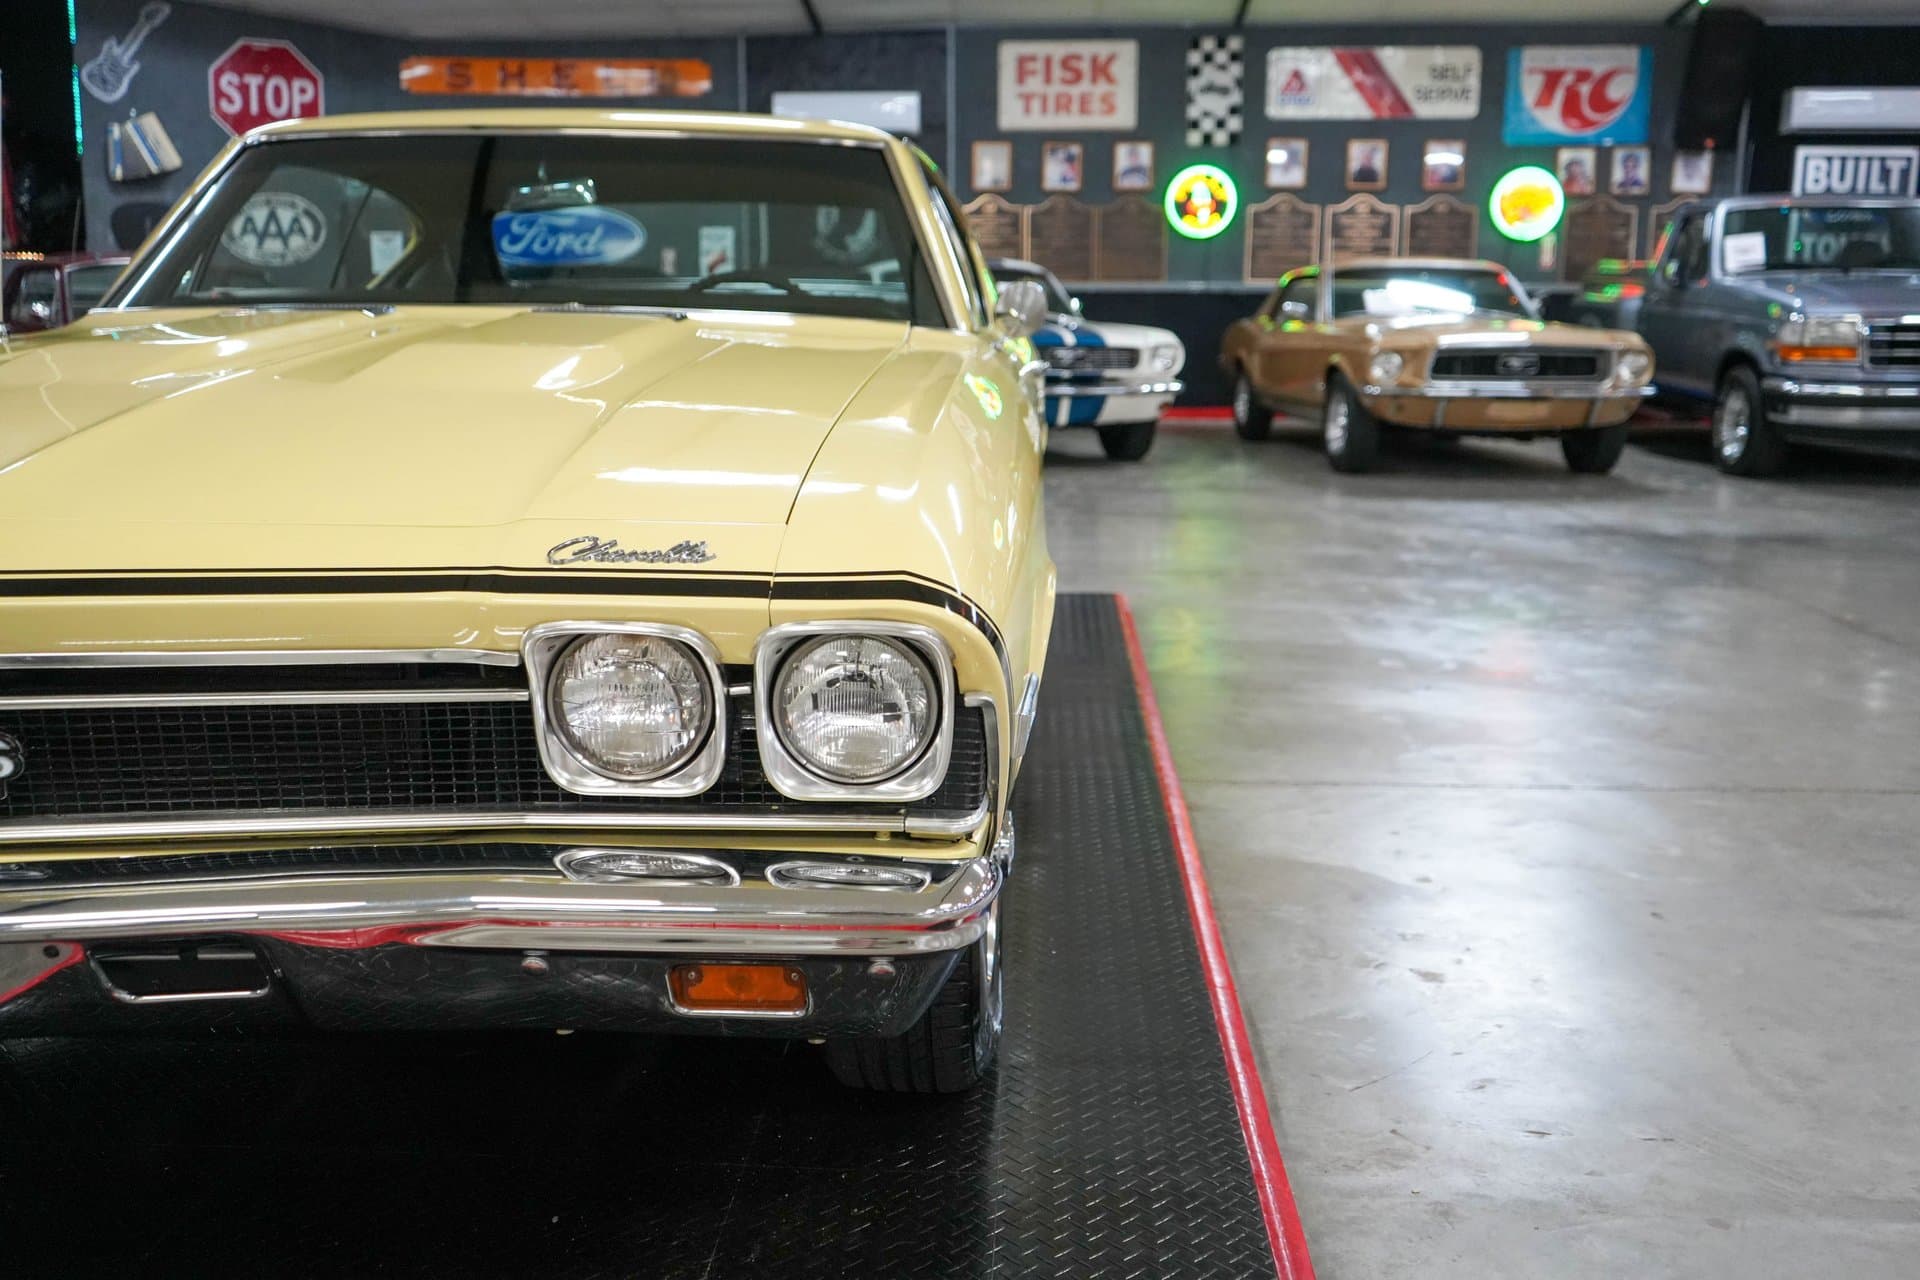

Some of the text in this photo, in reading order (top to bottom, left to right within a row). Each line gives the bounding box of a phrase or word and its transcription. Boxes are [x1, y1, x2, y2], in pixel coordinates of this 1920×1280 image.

[1015, 53, 1117, 86] FISK
[1429, 64, 1473, 81] SELF
[219, 71, 315, 118] STOP
[1017, 92, 1117, 117] TIRES
[1414, 86, 1473, 104] SERVE
[1527, 66, 1636, 133] RC
[1804, 157, 1909, 195] BUILT
[240, 206, 306, 249] AAA
[501, 212, 605, 255] Ford
[547, 535, 717, 566] Chevelle
